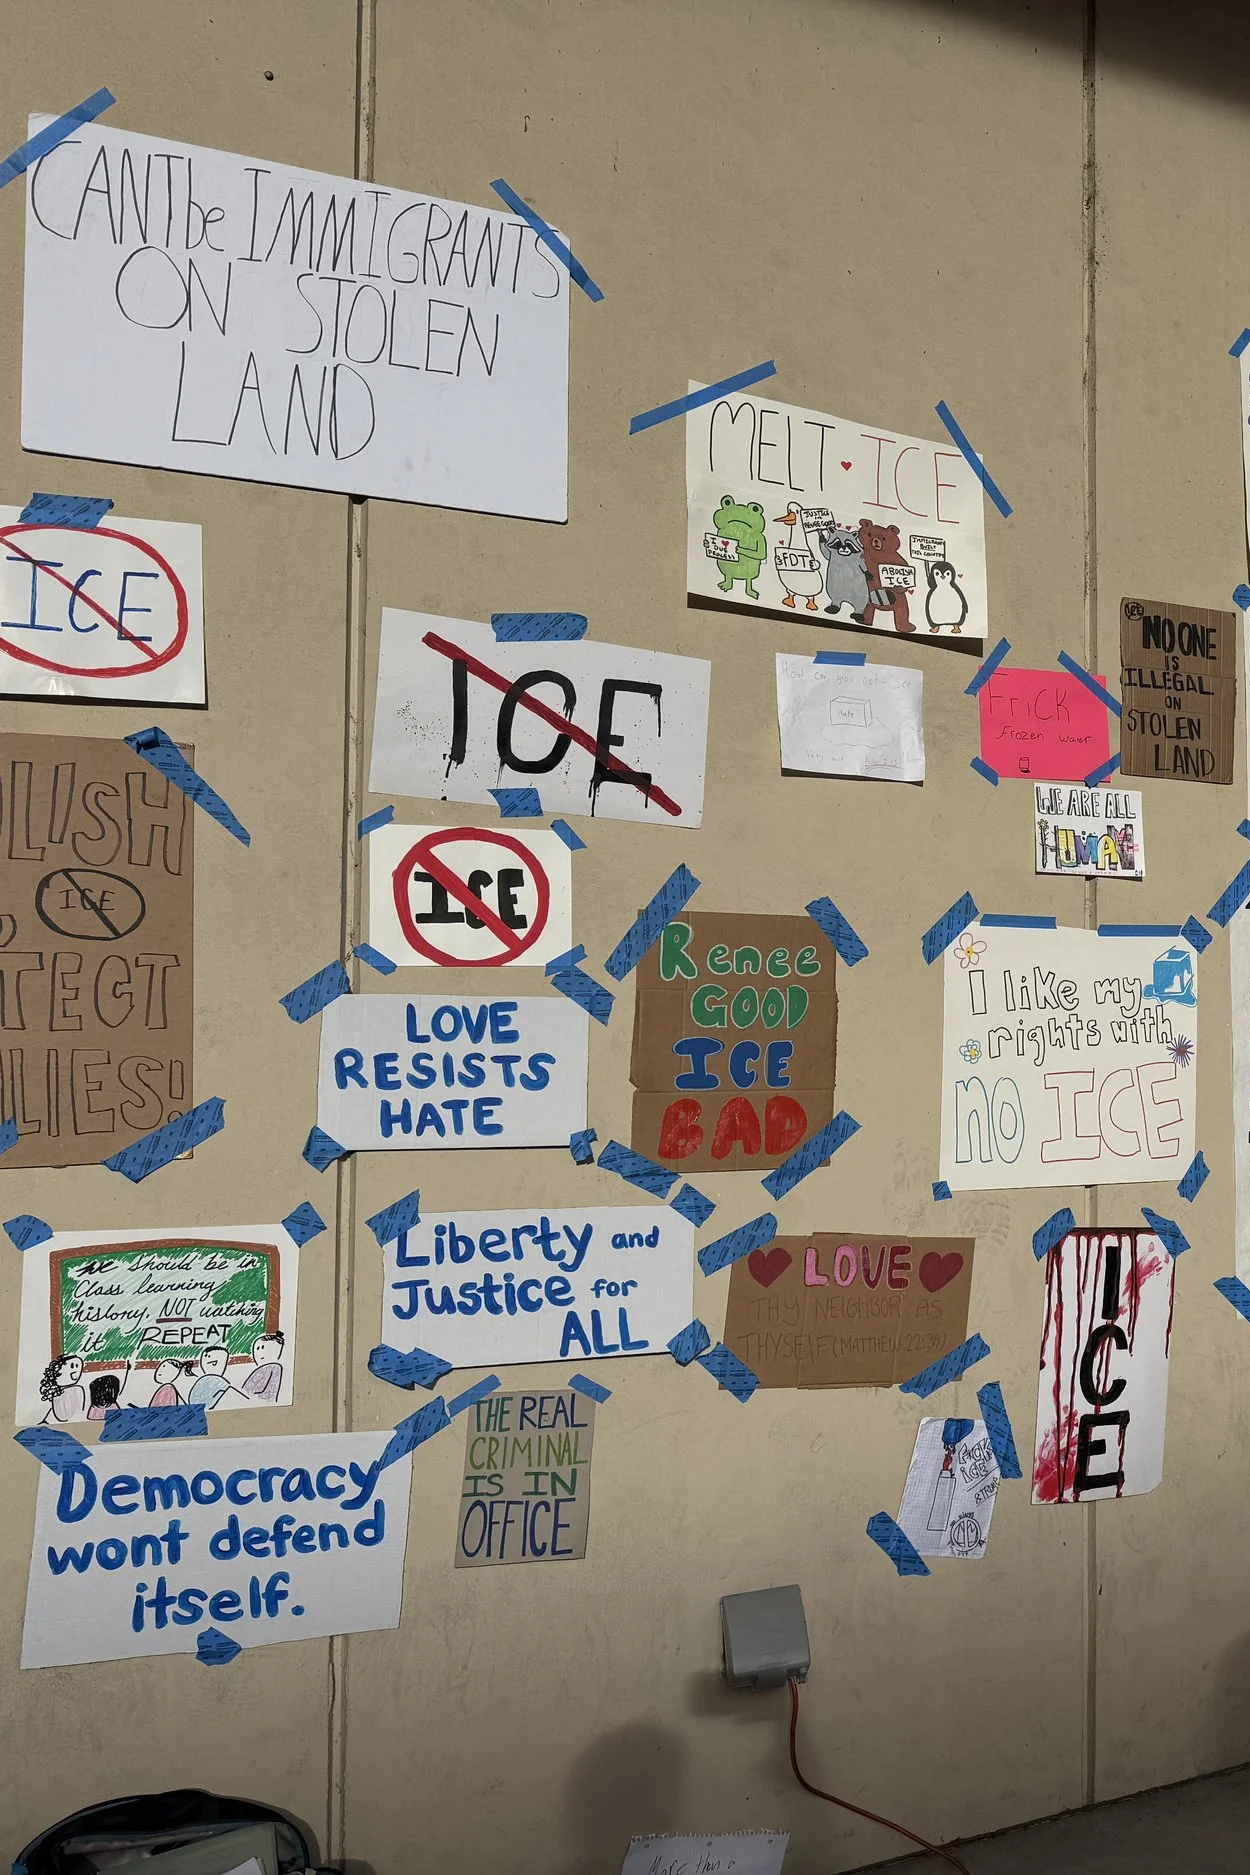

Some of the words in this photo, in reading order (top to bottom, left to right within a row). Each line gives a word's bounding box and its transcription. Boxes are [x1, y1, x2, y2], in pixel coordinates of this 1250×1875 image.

[237, 168, 561, 300] IMMIGRANTS
[115, 246, 232, 337] ON
[284, 273, 500, 378] STOLEN
[172, 341, 377, 462] LAND
[709, 400, 836, 493] MELT
[860, 433, 963, 525] ICE
[1, 554, 161, 642] ICE
[1123, 667, 1215, 695] ILLEGAL
[1165, 654, 1180, 671] IS
[1127, 708, 1202, 741] STOLEN
[1165, 694, 1183, 711] ON
[440, 658, 664, 802] ICE
[1153, 744, 1216, 779] LAND
[1036, 786, 1065, 815] WE
[1067, 790, 1101, 818] ARE
[1105, 792, 1136, 819] ALL
[58, 887, 116, 912] ICE
[413, 867, 528, 929] ICE
[658, 921, 823, 982] Renee
[405, 1000, 520, 1046] LOVE
[691, 984, 809, 1030] GOOD
[987, 1012, 1101, 1067] rights
[1110, 1004, 1175, 1045] with
[334, 1047, 558, 1091] RESISTS
[671, 1036, 795, 1091] ICE
[380, 1096, 505, 1140] HATE
[657, 1095, 809, 1160] BAD
[393, 1215, 595, 1272] Liberty
[611, 1226, 660, 1251] and
[804, 1244, 914, 1291] LOVE
[391, 1271, 577, 1320] Justice
[590, 1275, 638, 1299] for
[80, 1332, 105, 1354] it
[137, 1323, 233, 1351] REPEAT
[559, 1307, 650, 1358] ALL
[1075, 1245, 1130, 1491] ICE
[474, 1395, 512, 1435] THE
[518, 1393, 589, 1430] REAL
[467, 1429, 589, 1472] CRIMINAL
[54, 1456, 385, 1525] Democracy
[463, 1473, 505, 1498] IS
[522, 1471, 578, 1498] IN
[48, 1518, 191, 1577] wont
[208, 1499, 387, 1560] defend
[460, 1497, 578, 1558] OFFICE
[131, 1570, 306, 1632] itself.
